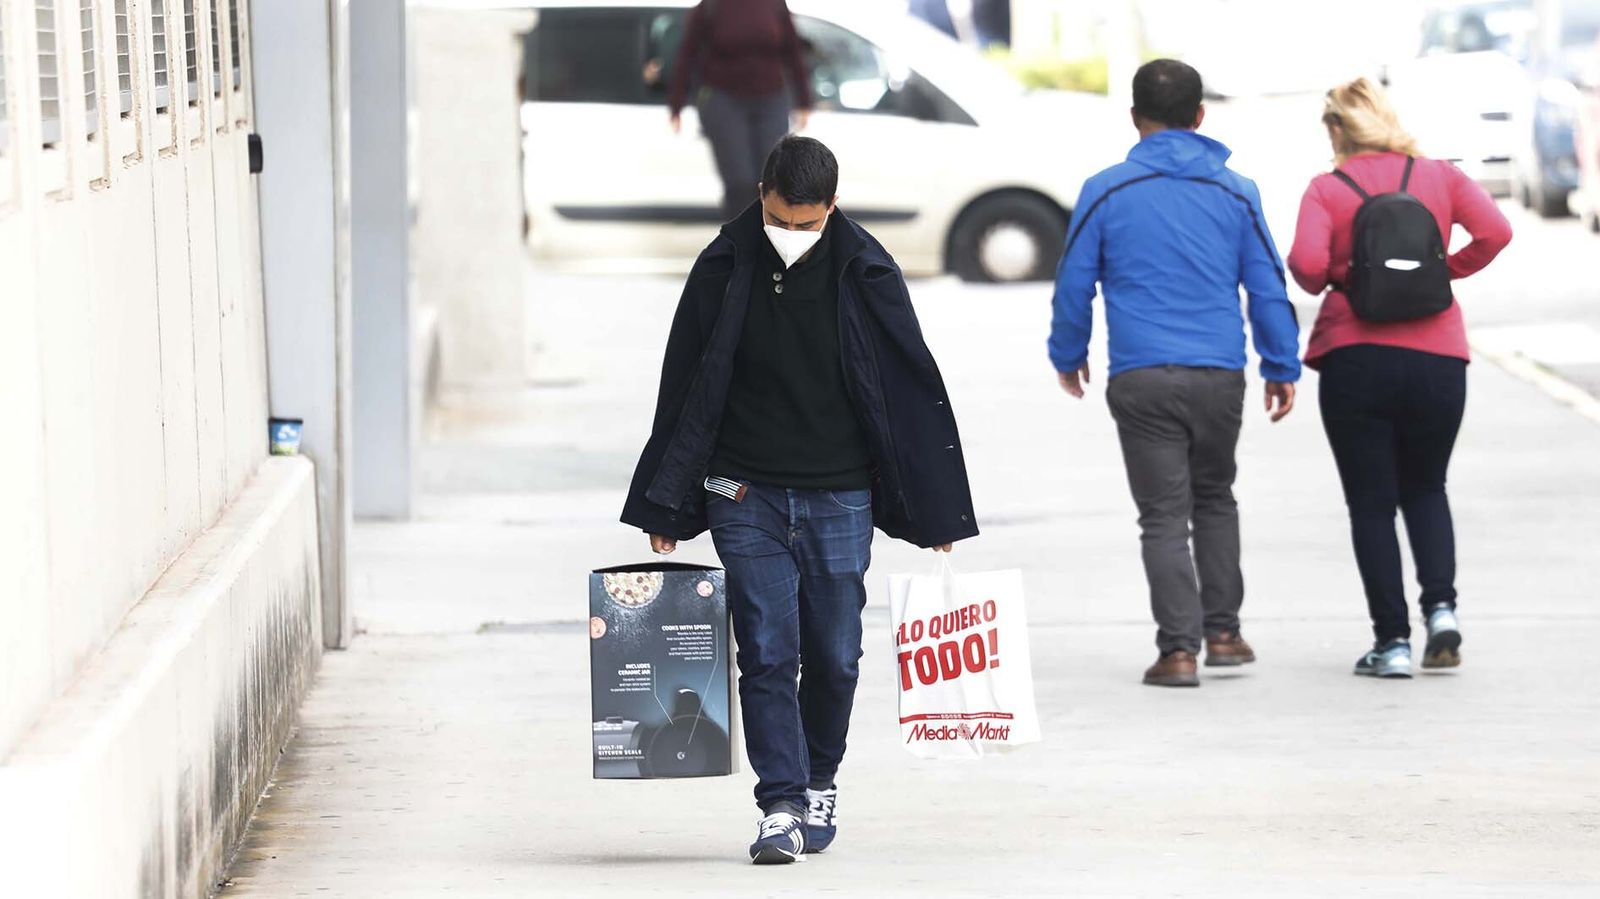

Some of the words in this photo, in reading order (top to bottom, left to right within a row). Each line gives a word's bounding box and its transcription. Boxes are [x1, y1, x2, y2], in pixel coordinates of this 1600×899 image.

[928, 599, 997, 640] QUIERO
[897, 627, 1000, 692] TODO!
[906, 723, 958, 744] Media
[970, 722, 1010, 741] Markt
